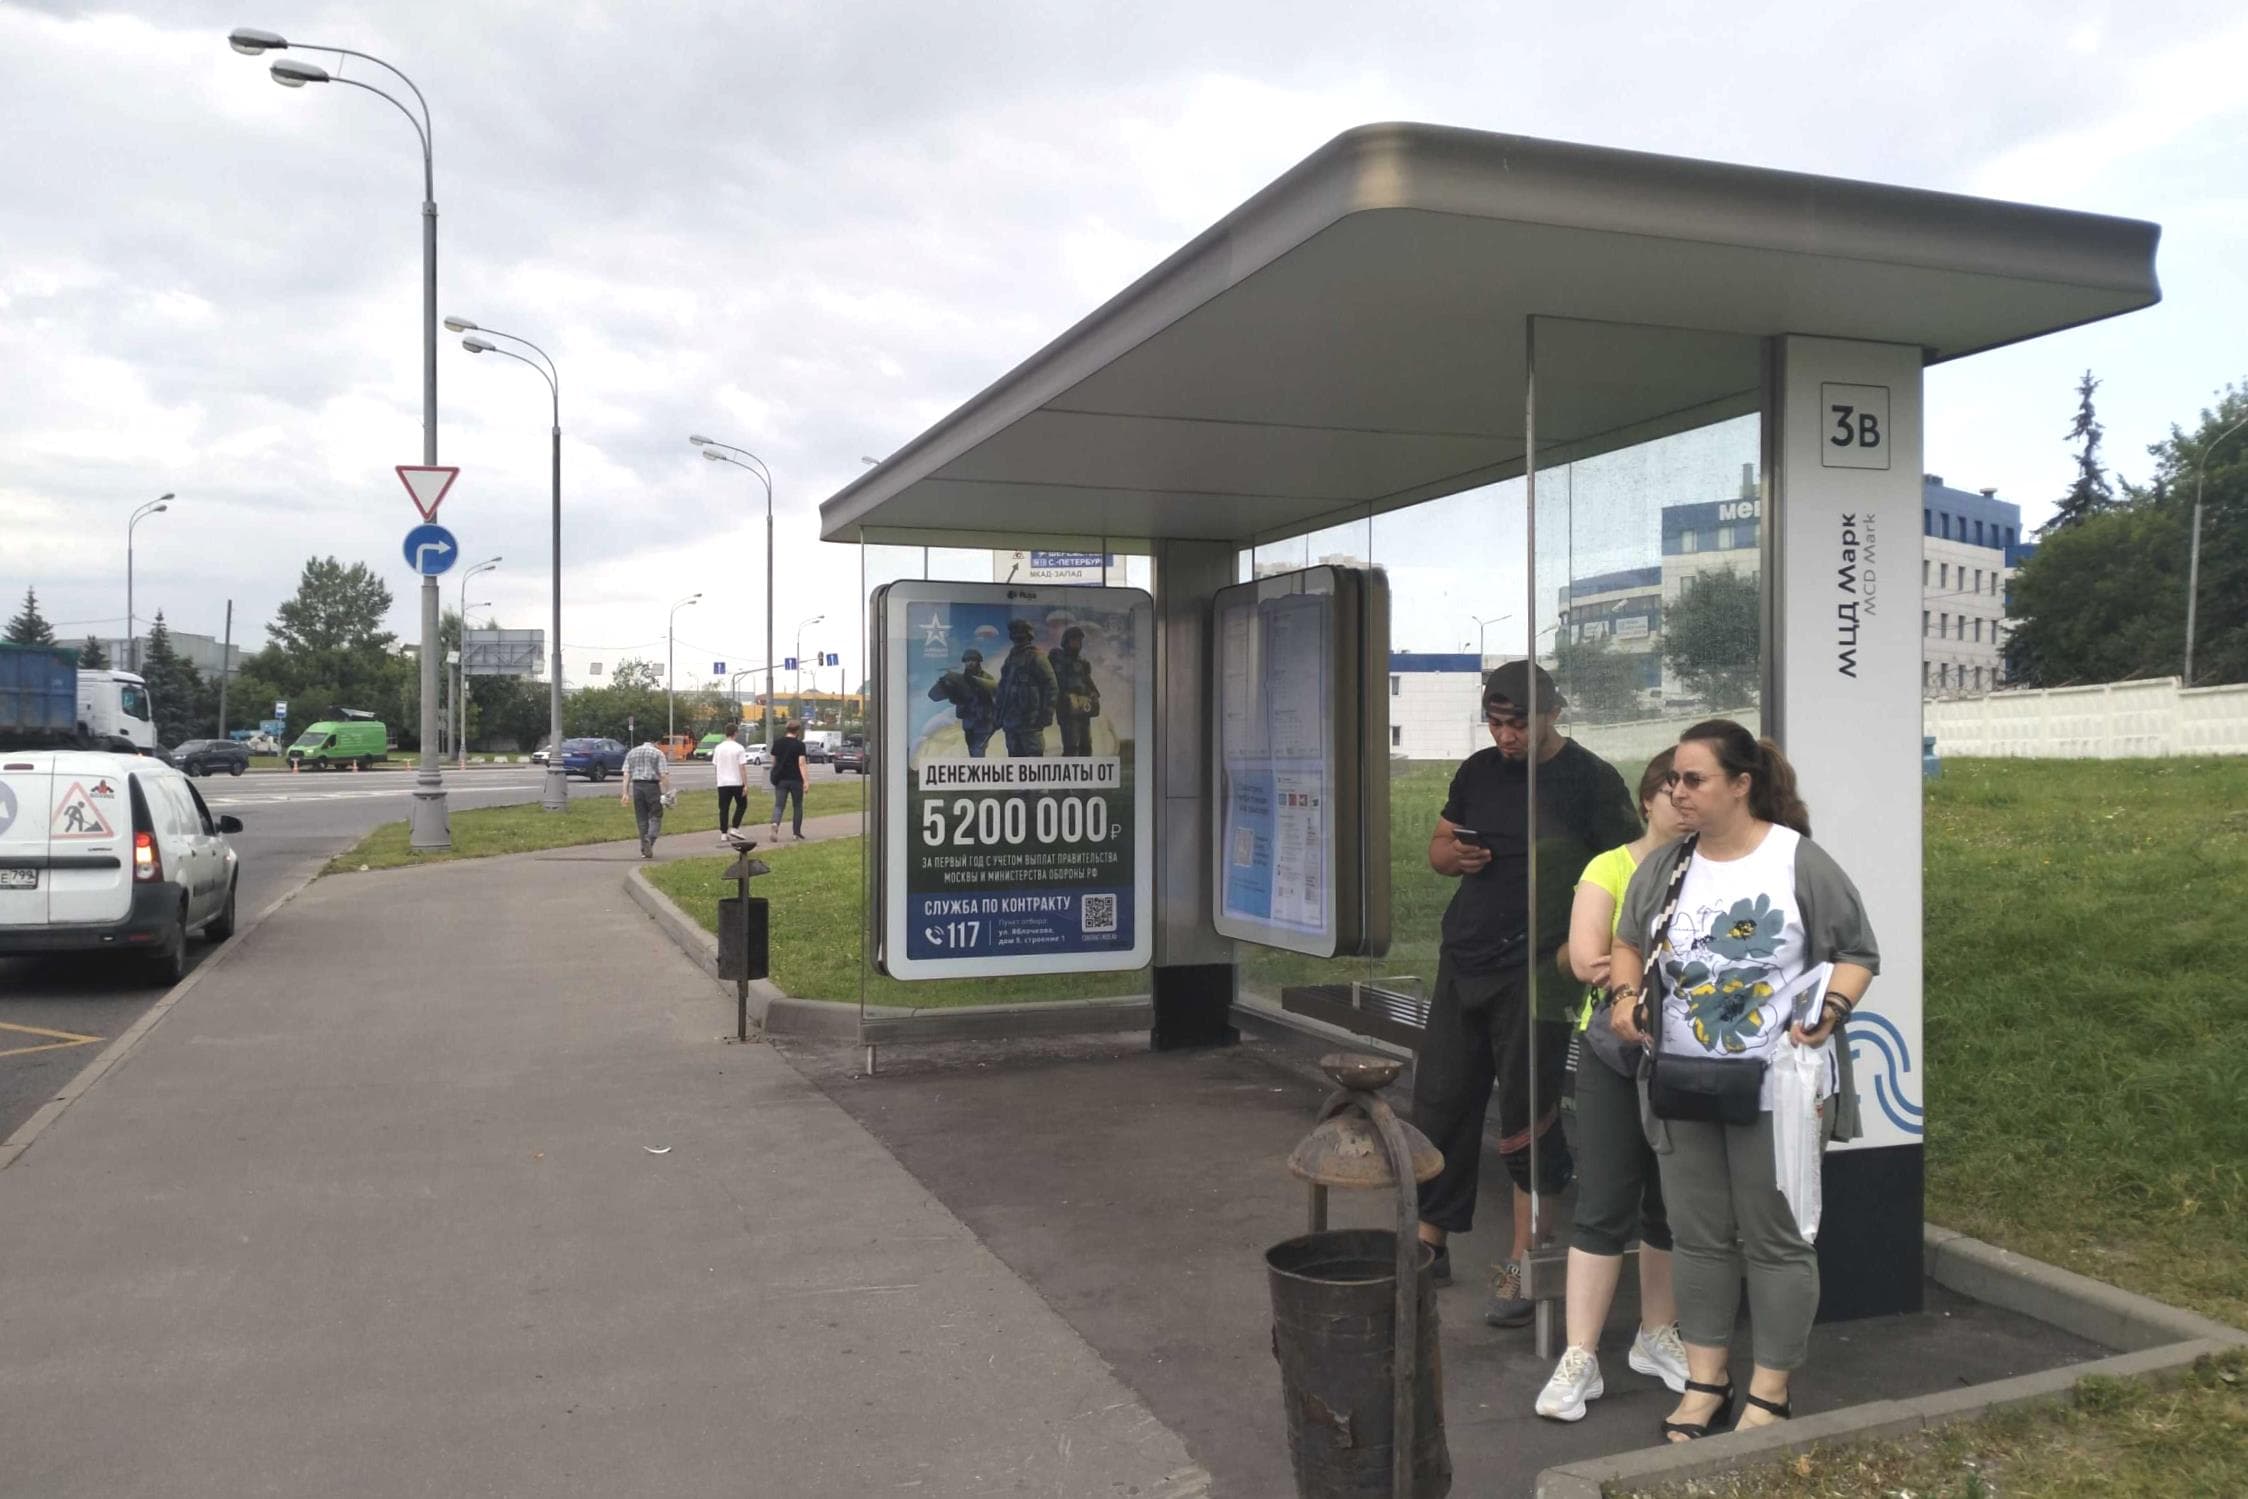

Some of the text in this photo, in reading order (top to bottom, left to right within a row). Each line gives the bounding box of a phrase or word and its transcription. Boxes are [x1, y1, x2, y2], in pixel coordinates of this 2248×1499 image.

[1863, 512, 1876, 616] MCD Mark
[1837, 513, 1861, 678] МЦД Марк
[925, 763, 1115, 786] ДЕНЕЖНЫЕ ВЫПЛАТЫ ОТ
[922, 798, 946, 847] 5
[952, 797, 1027, 846] 200
[922, 857, 933, 869] ЗА
[934, 853, 967, 868] ПЕРВЫЙ
[969, 855, 984, 868] ГОД
[985, 855, 992, 867] С
[1025, 853, 1056, 866] ВЫПЛАТ
[1057, 851, 1118, 864] ПРАВИТЕЛЬСТВА
[944, 866, 1098, 883] МОСКВЫ И МИНИСТЕРСТВА ОБОРОНЫ РФ
[924, 896, 1071, 916] СЛУЖБА ПО КОНТРАКТУ
[947, 921, 980, 948] 117
